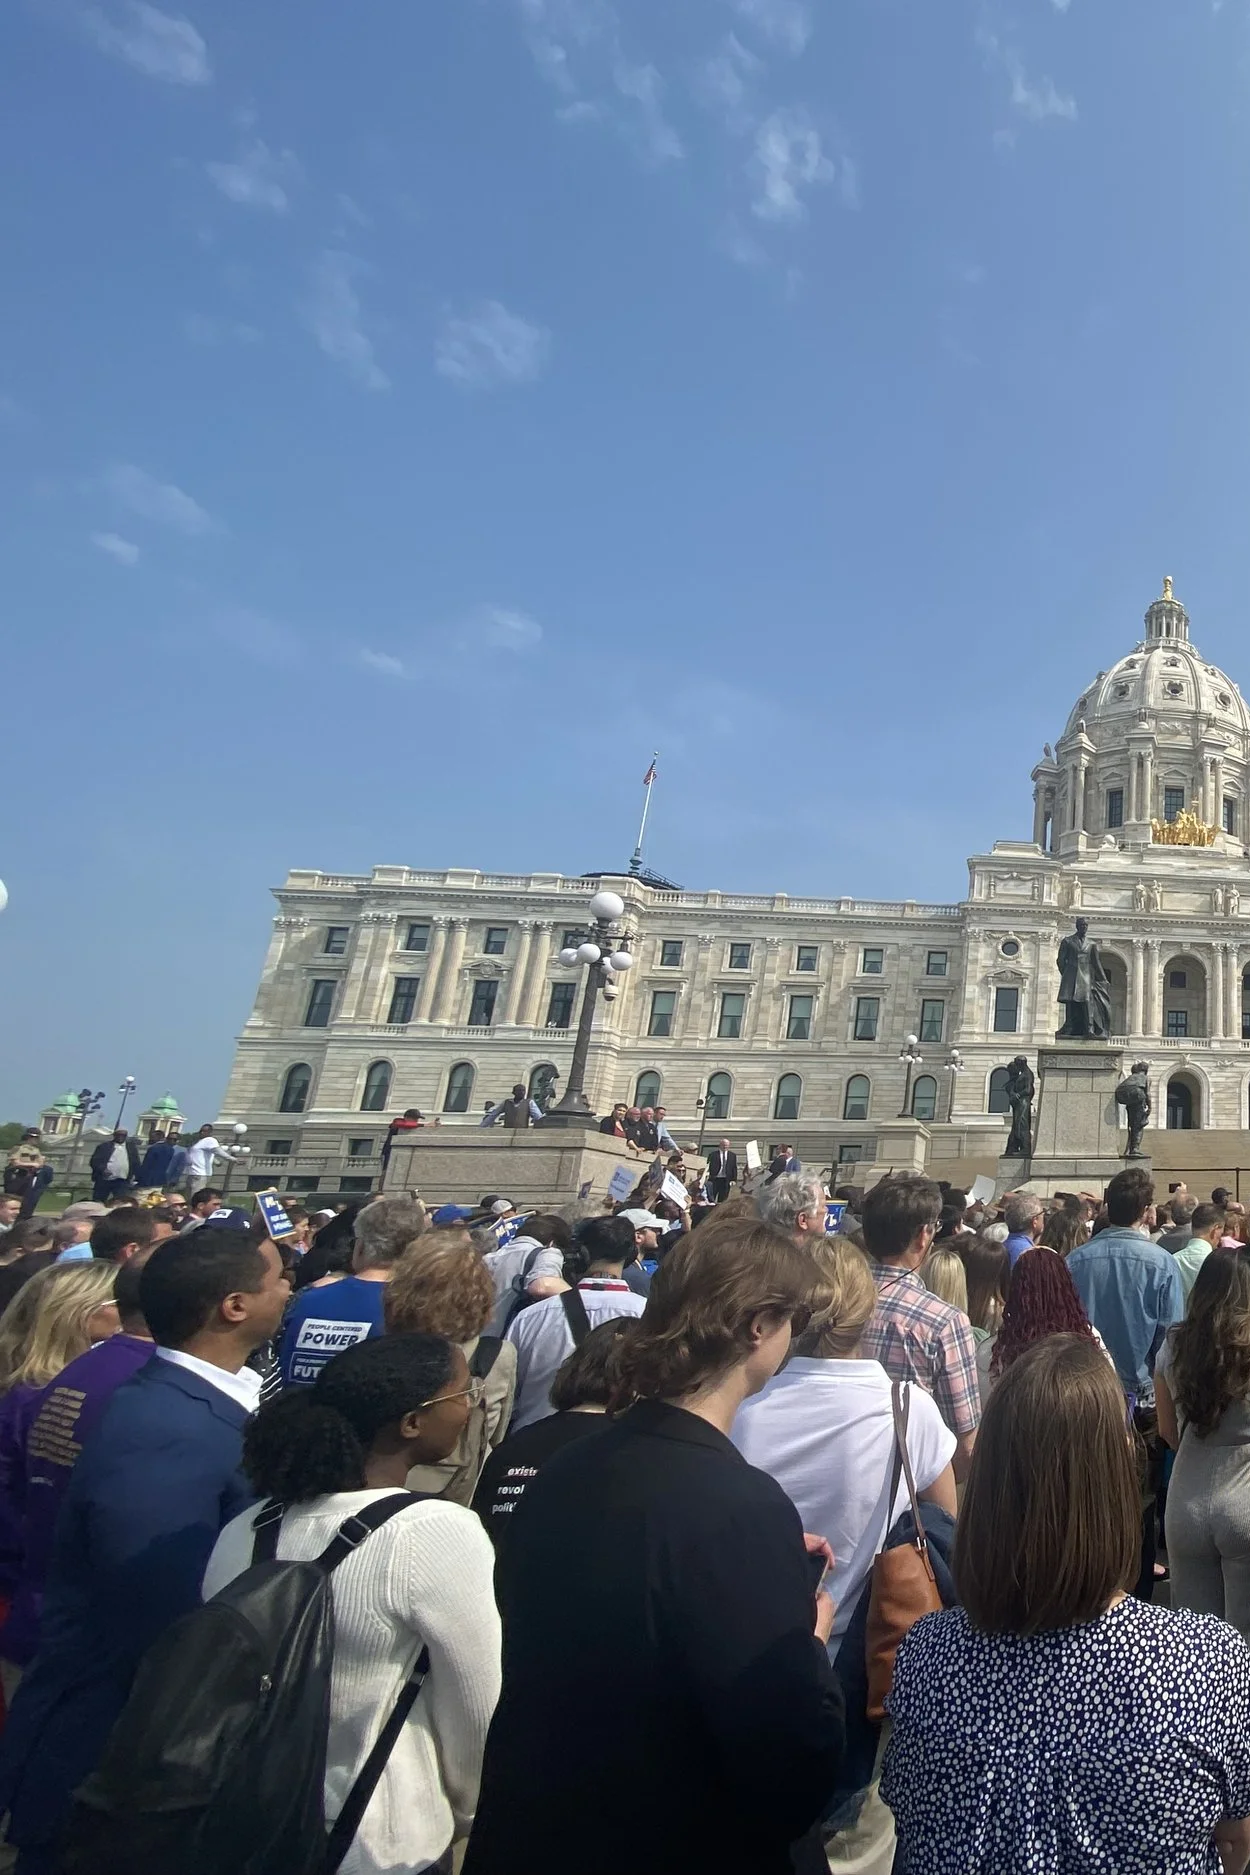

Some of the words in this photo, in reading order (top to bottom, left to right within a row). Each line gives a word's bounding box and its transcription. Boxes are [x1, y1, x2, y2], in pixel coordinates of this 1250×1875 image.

[302, 1332, 359, 1346] POWER
[294, 1365, 323, 1378] FUT
[492, 1502, 517, 1514] polit
